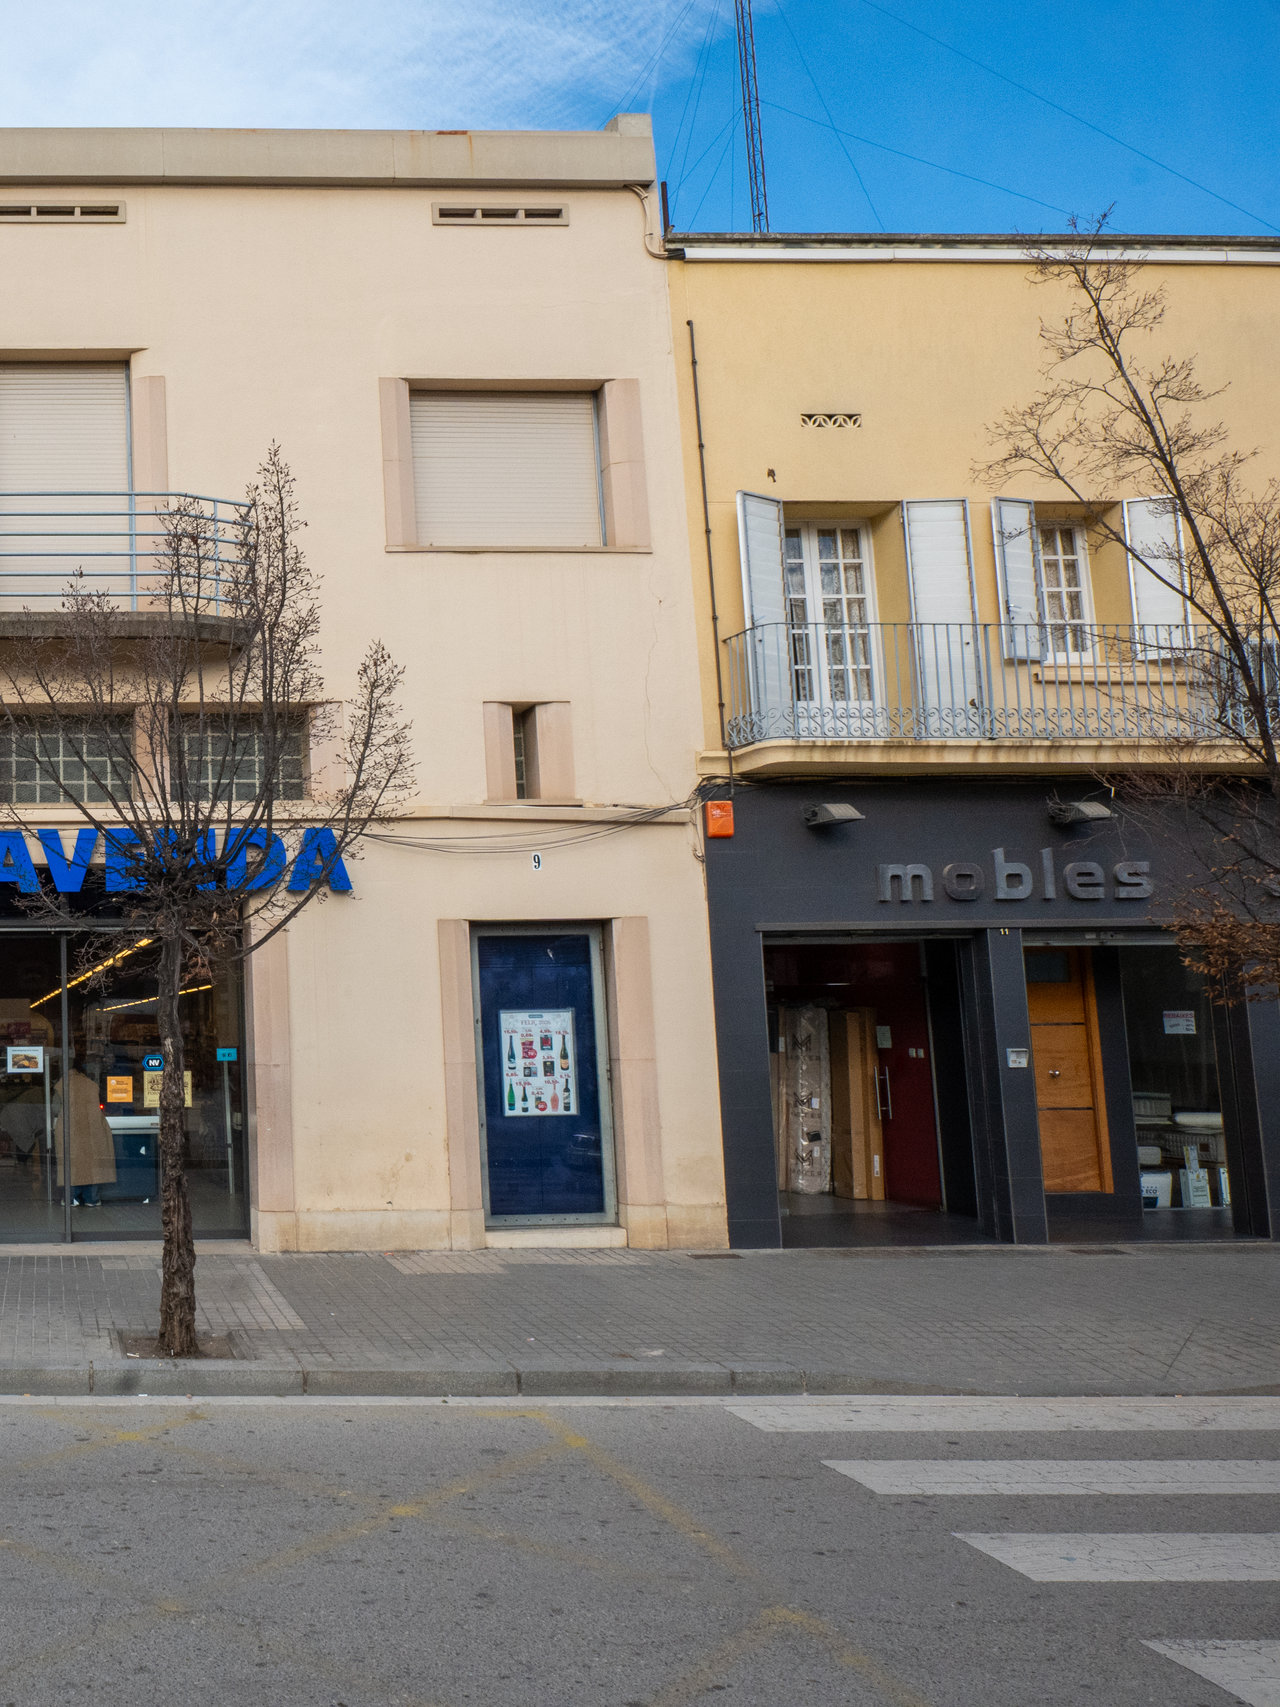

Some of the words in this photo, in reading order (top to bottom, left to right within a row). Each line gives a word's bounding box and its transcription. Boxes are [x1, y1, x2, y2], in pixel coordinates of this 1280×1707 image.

[533, 854, 541, 870] 9
[876, 847, 1154, 901] mobles
[149, 1059, 160, 1067] NV
